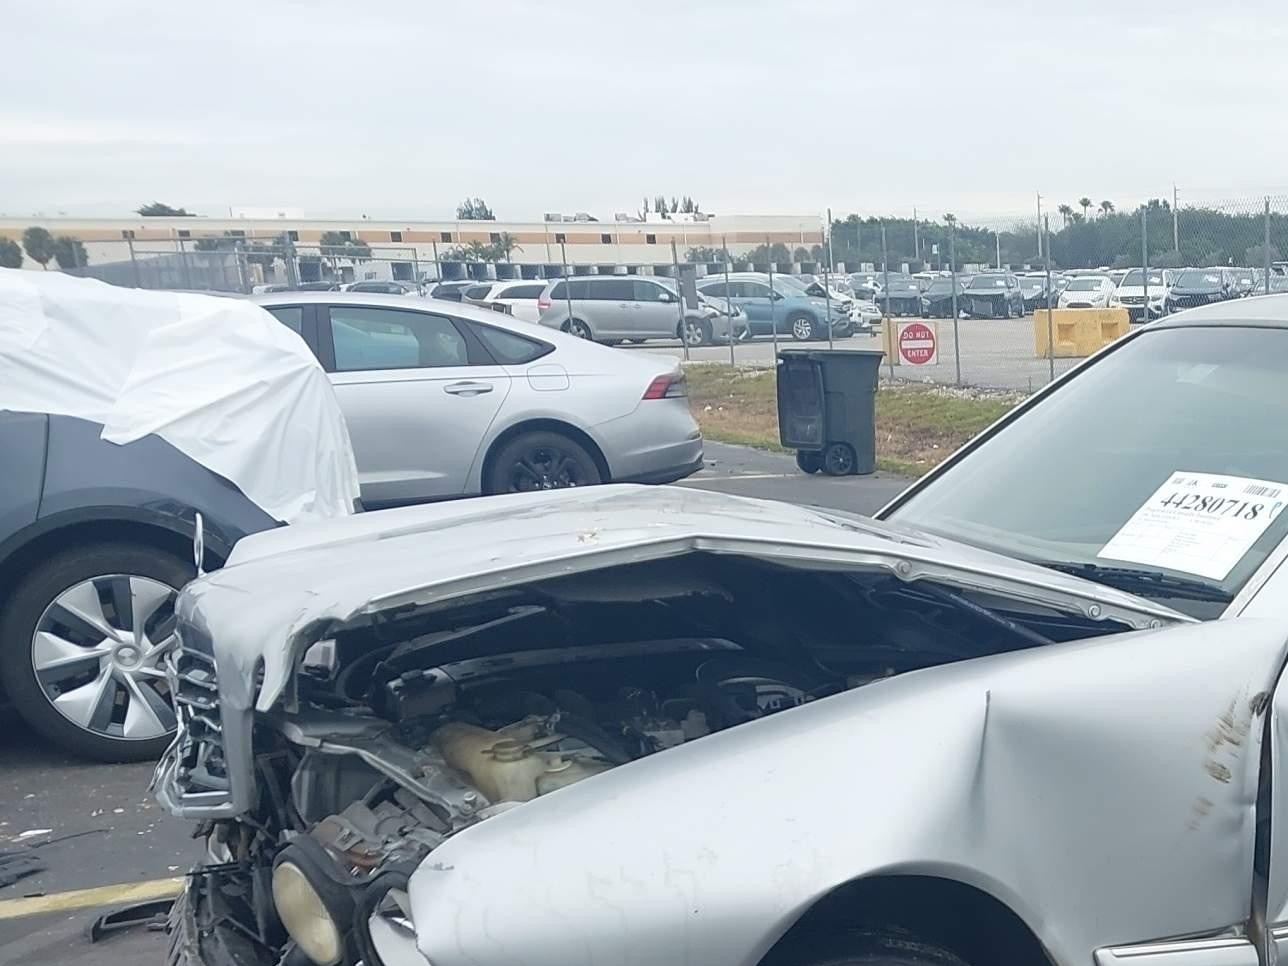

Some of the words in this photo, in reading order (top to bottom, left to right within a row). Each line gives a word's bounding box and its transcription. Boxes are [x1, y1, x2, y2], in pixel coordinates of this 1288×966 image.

[903, 331, 914, 340] DO
[915, 331, 930, 339] NOT
[907, 349, 929, 358] ENTER
[1160, 491, 1265, 521] 44280718
